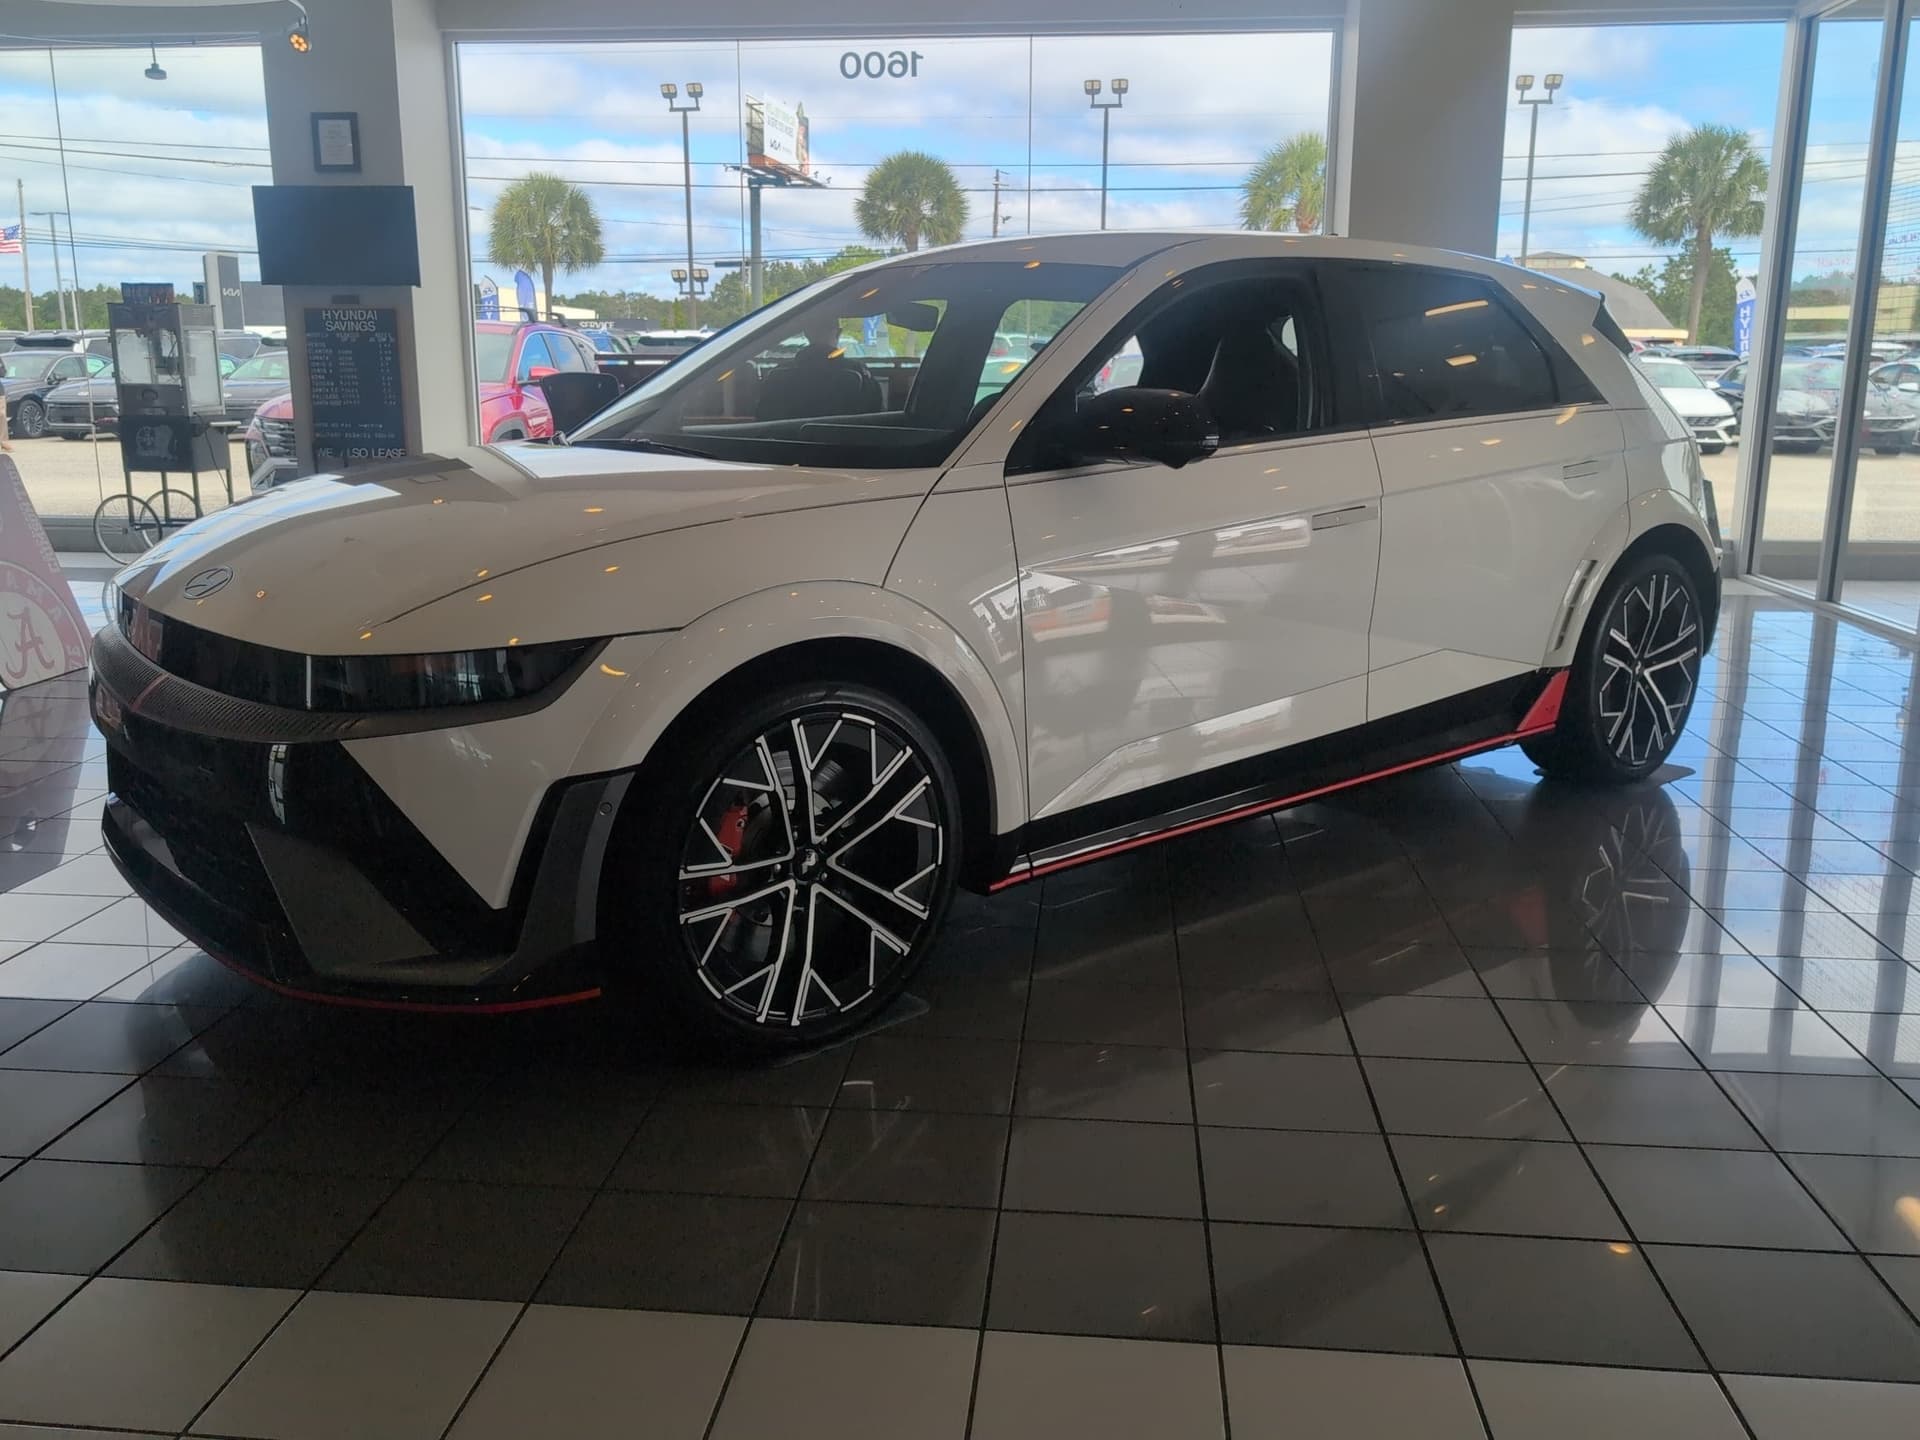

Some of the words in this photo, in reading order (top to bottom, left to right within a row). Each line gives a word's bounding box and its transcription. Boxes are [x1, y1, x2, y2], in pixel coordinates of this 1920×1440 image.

[322, 310, 377, 321] HYUNDAI
[325, 321, 376, 332] SAVINGS
[579, 321, 615, 329] SERVICE
[371, 447, 407, 458] LEASE
